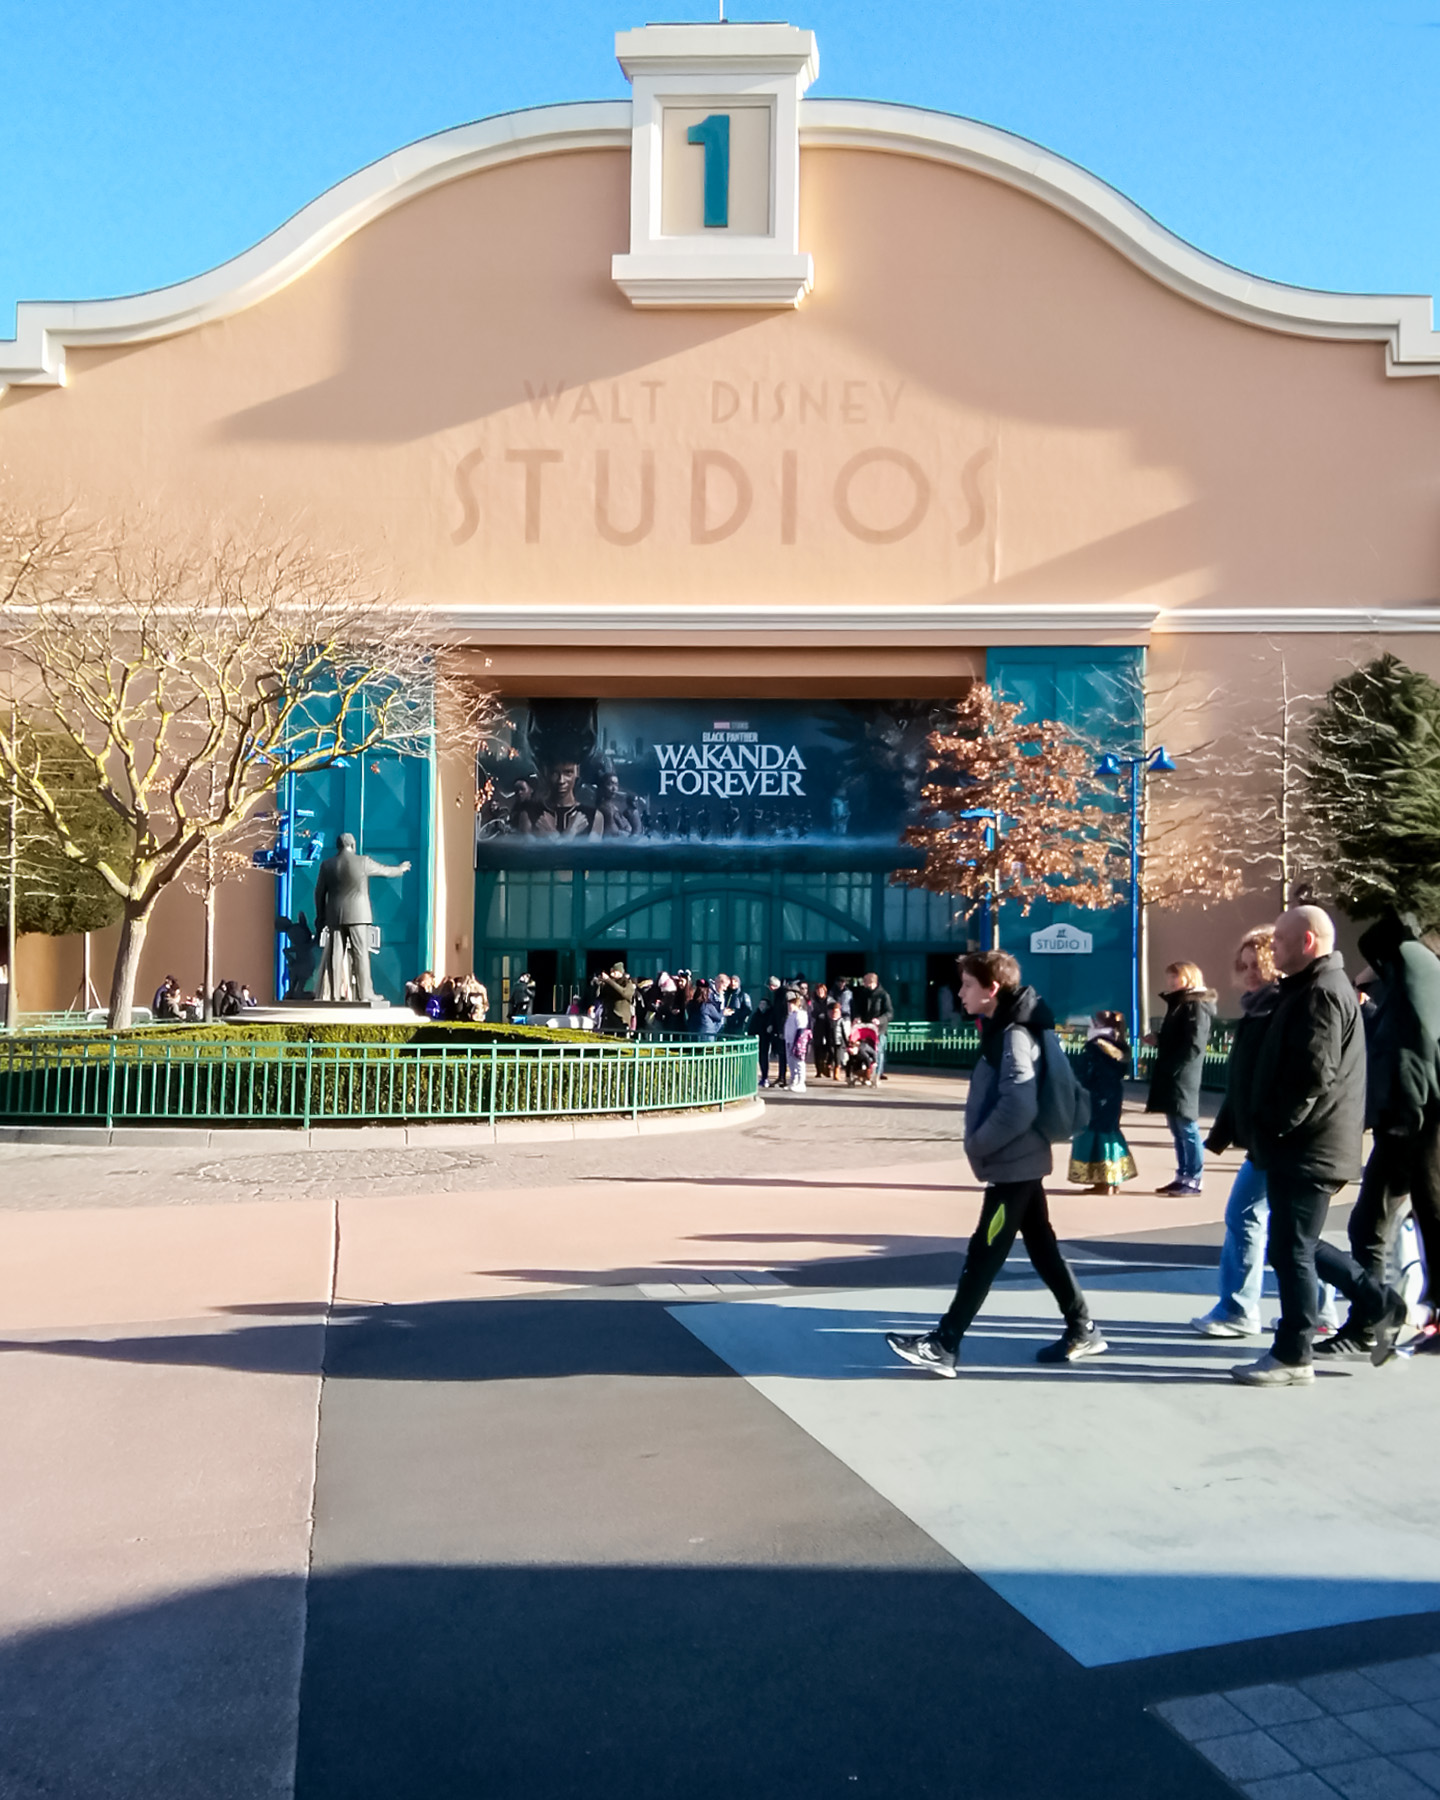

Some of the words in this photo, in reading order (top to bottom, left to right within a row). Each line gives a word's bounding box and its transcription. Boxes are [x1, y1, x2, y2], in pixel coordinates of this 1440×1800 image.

[687, 114, 730, 228] 1
[523, 379, 665, 424] WALT
[712, 380, 905, 424] DISNEY
[450, 446, 993, 547] STUDIOS
[652, 744, 807, 770] WAKANDA
[657, 770, 807, 799] FOREVER
[1036, 938, 1080, 950] STUDIO
